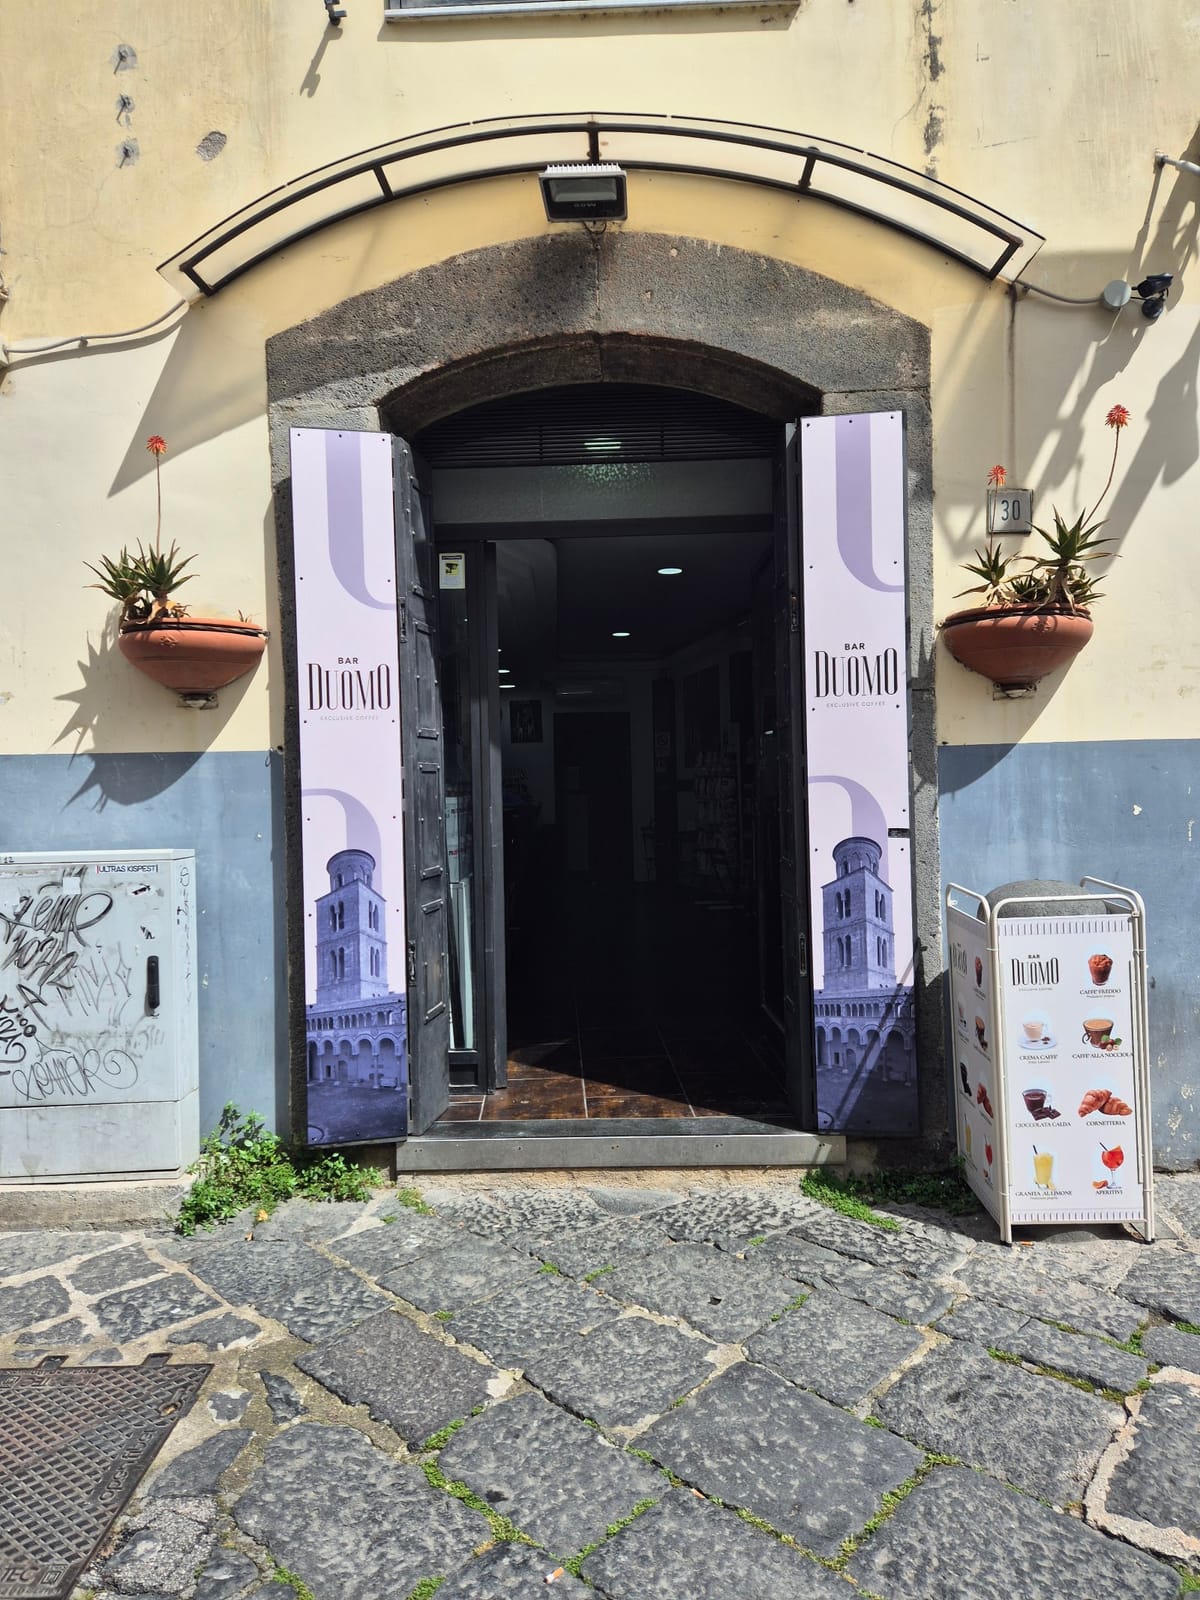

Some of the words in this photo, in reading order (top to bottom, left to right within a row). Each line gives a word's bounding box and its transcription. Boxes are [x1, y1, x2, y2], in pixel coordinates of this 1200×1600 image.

[1001, 499, 1021, 521] 30
[306, 663, 391, 711] DUOMO
[814, 647, 898, 698] DUOMO
[99, 864, 126, 873] ULTRAS
[127, 864, 155, 873] KISPEST
[1011, 957, 1060, 986] DUOMO
